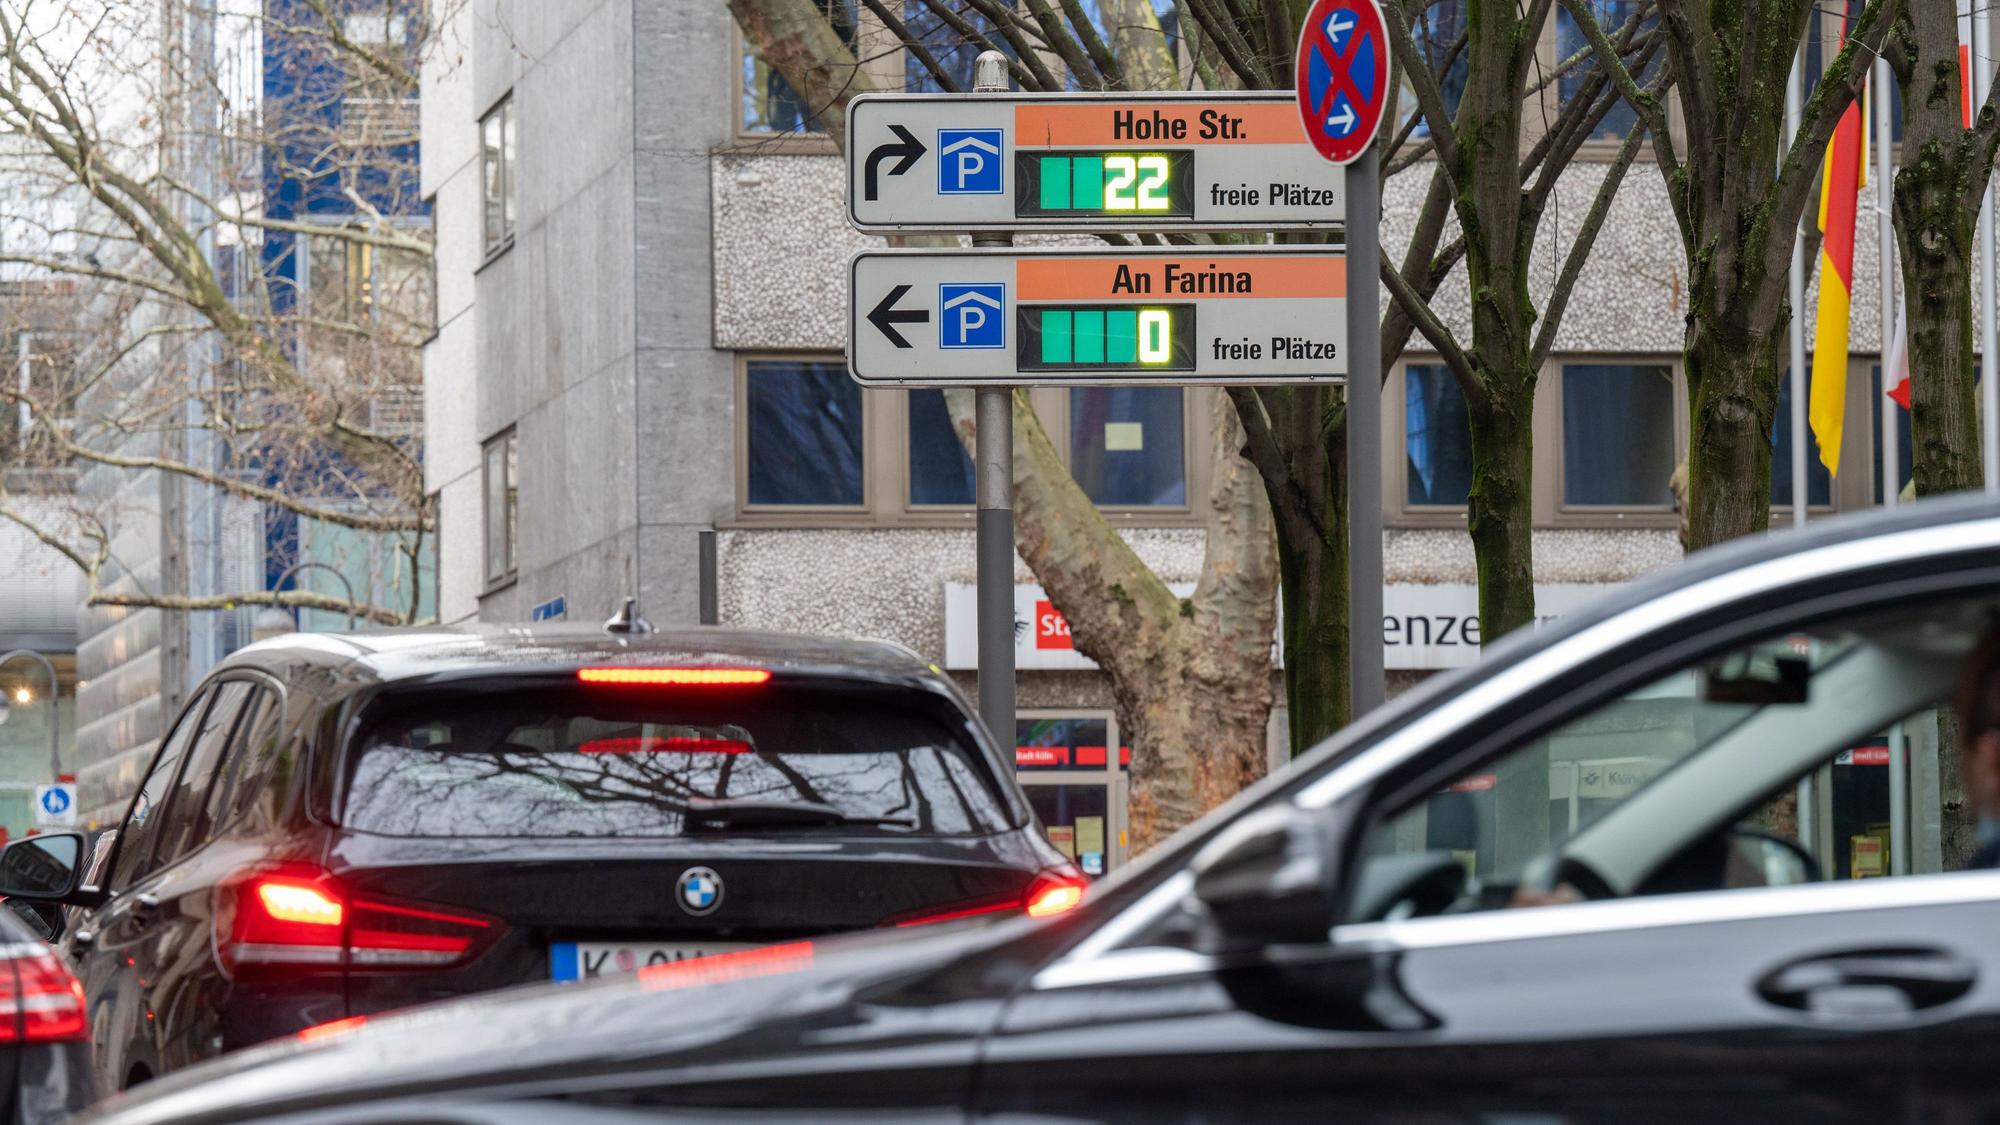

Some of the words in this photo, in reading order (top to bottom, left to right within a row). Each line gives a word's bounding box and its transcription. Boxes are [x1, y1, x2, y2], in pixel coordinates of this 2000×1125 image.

[1113, 110, 1187, 140] Hohe
[1199, 109, 1247, 139] Str.
[958, 152, 984, 189] P
[1104, 155, 1169, 210] 22
[1210, 183, 1260, 206] freie
[1269, 183, 1334, 206] Plätze
[1111, 264, 1151, 294] An
[1164, 263, 1252, 294] Farina
[960, 306, 986, 344] P
[1138, 309, 1170, 364] 0
[1212, 337, 1262, 360] freie
[1271, 337, 1336, 360] Plätze
